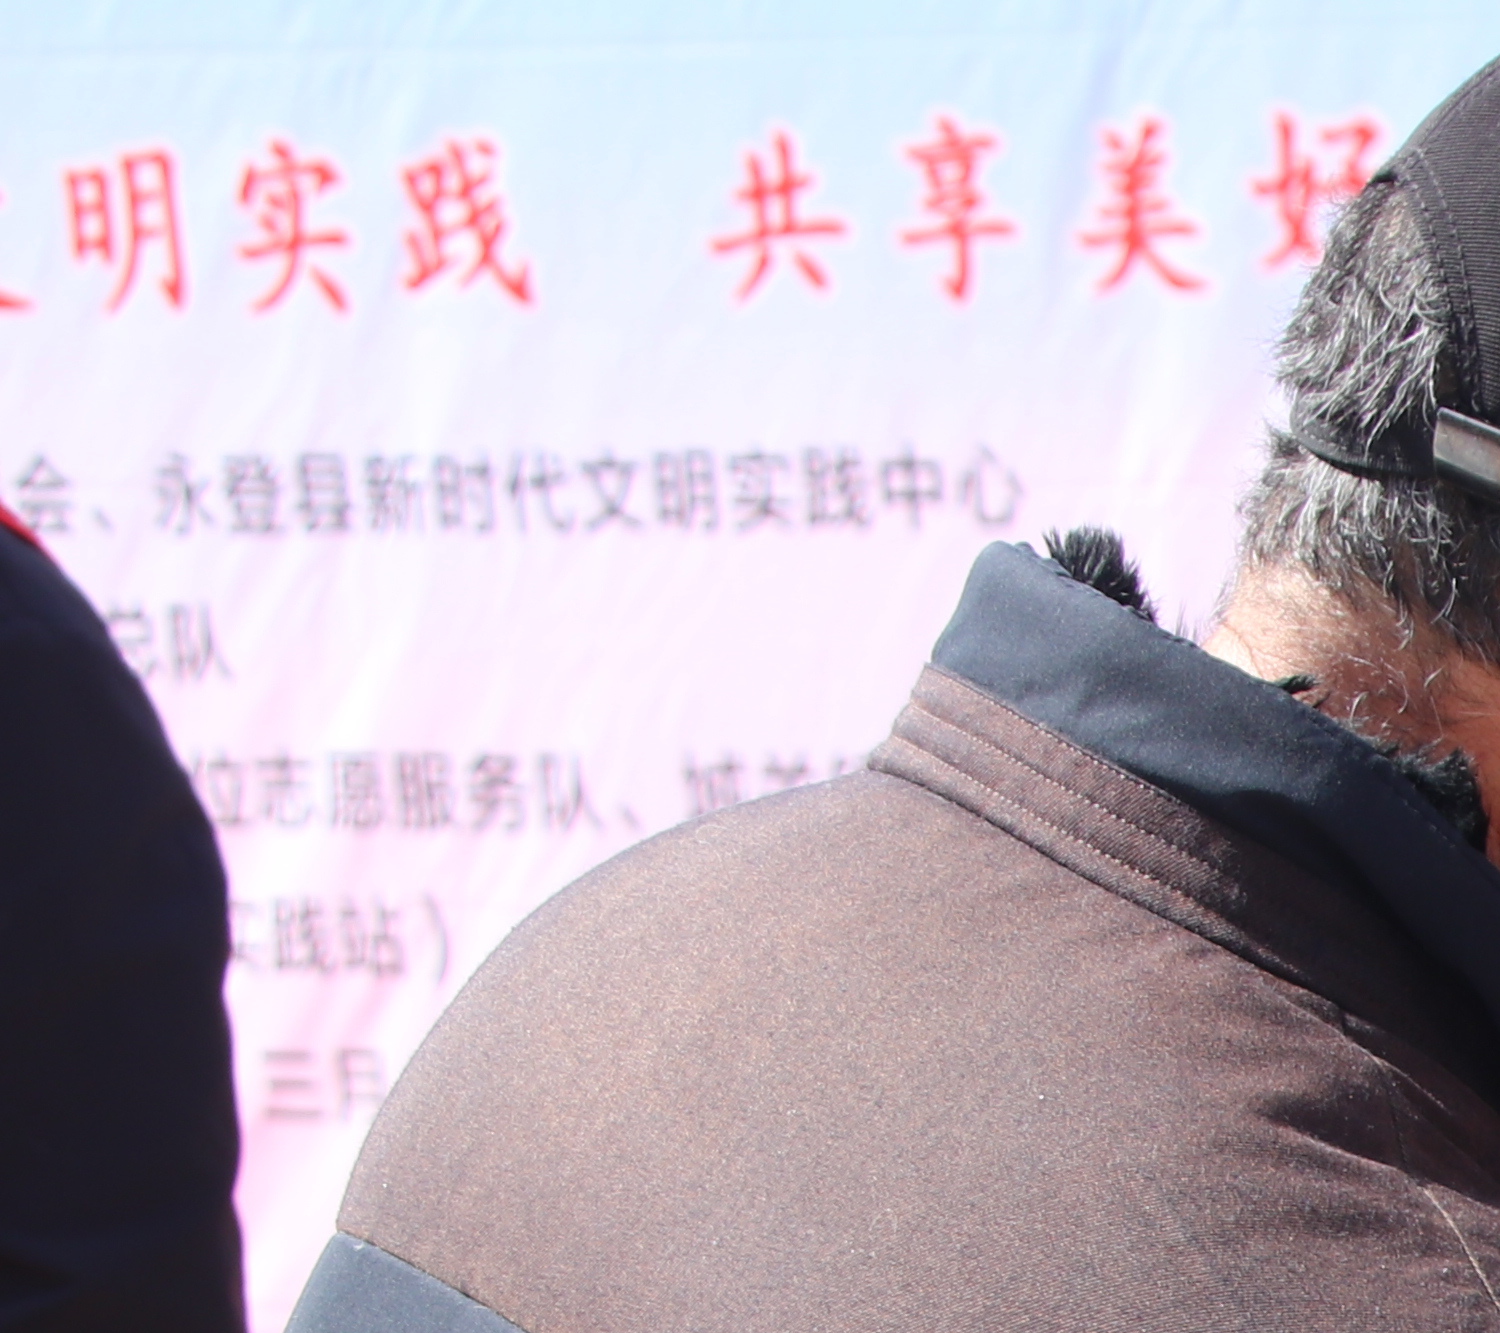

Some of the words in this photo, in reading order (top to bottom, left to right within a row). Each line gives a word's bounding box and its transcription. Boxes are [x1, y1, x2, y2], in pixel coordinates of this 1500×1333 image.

[0, 138, 536, 313] 明实践
[706, 108, 1389, 304] 共享美好
[14, 444, 1026, 536] 会、永登县新时代文明实践中心
[190, 748, 850, 834] 位志愿服务队、城
